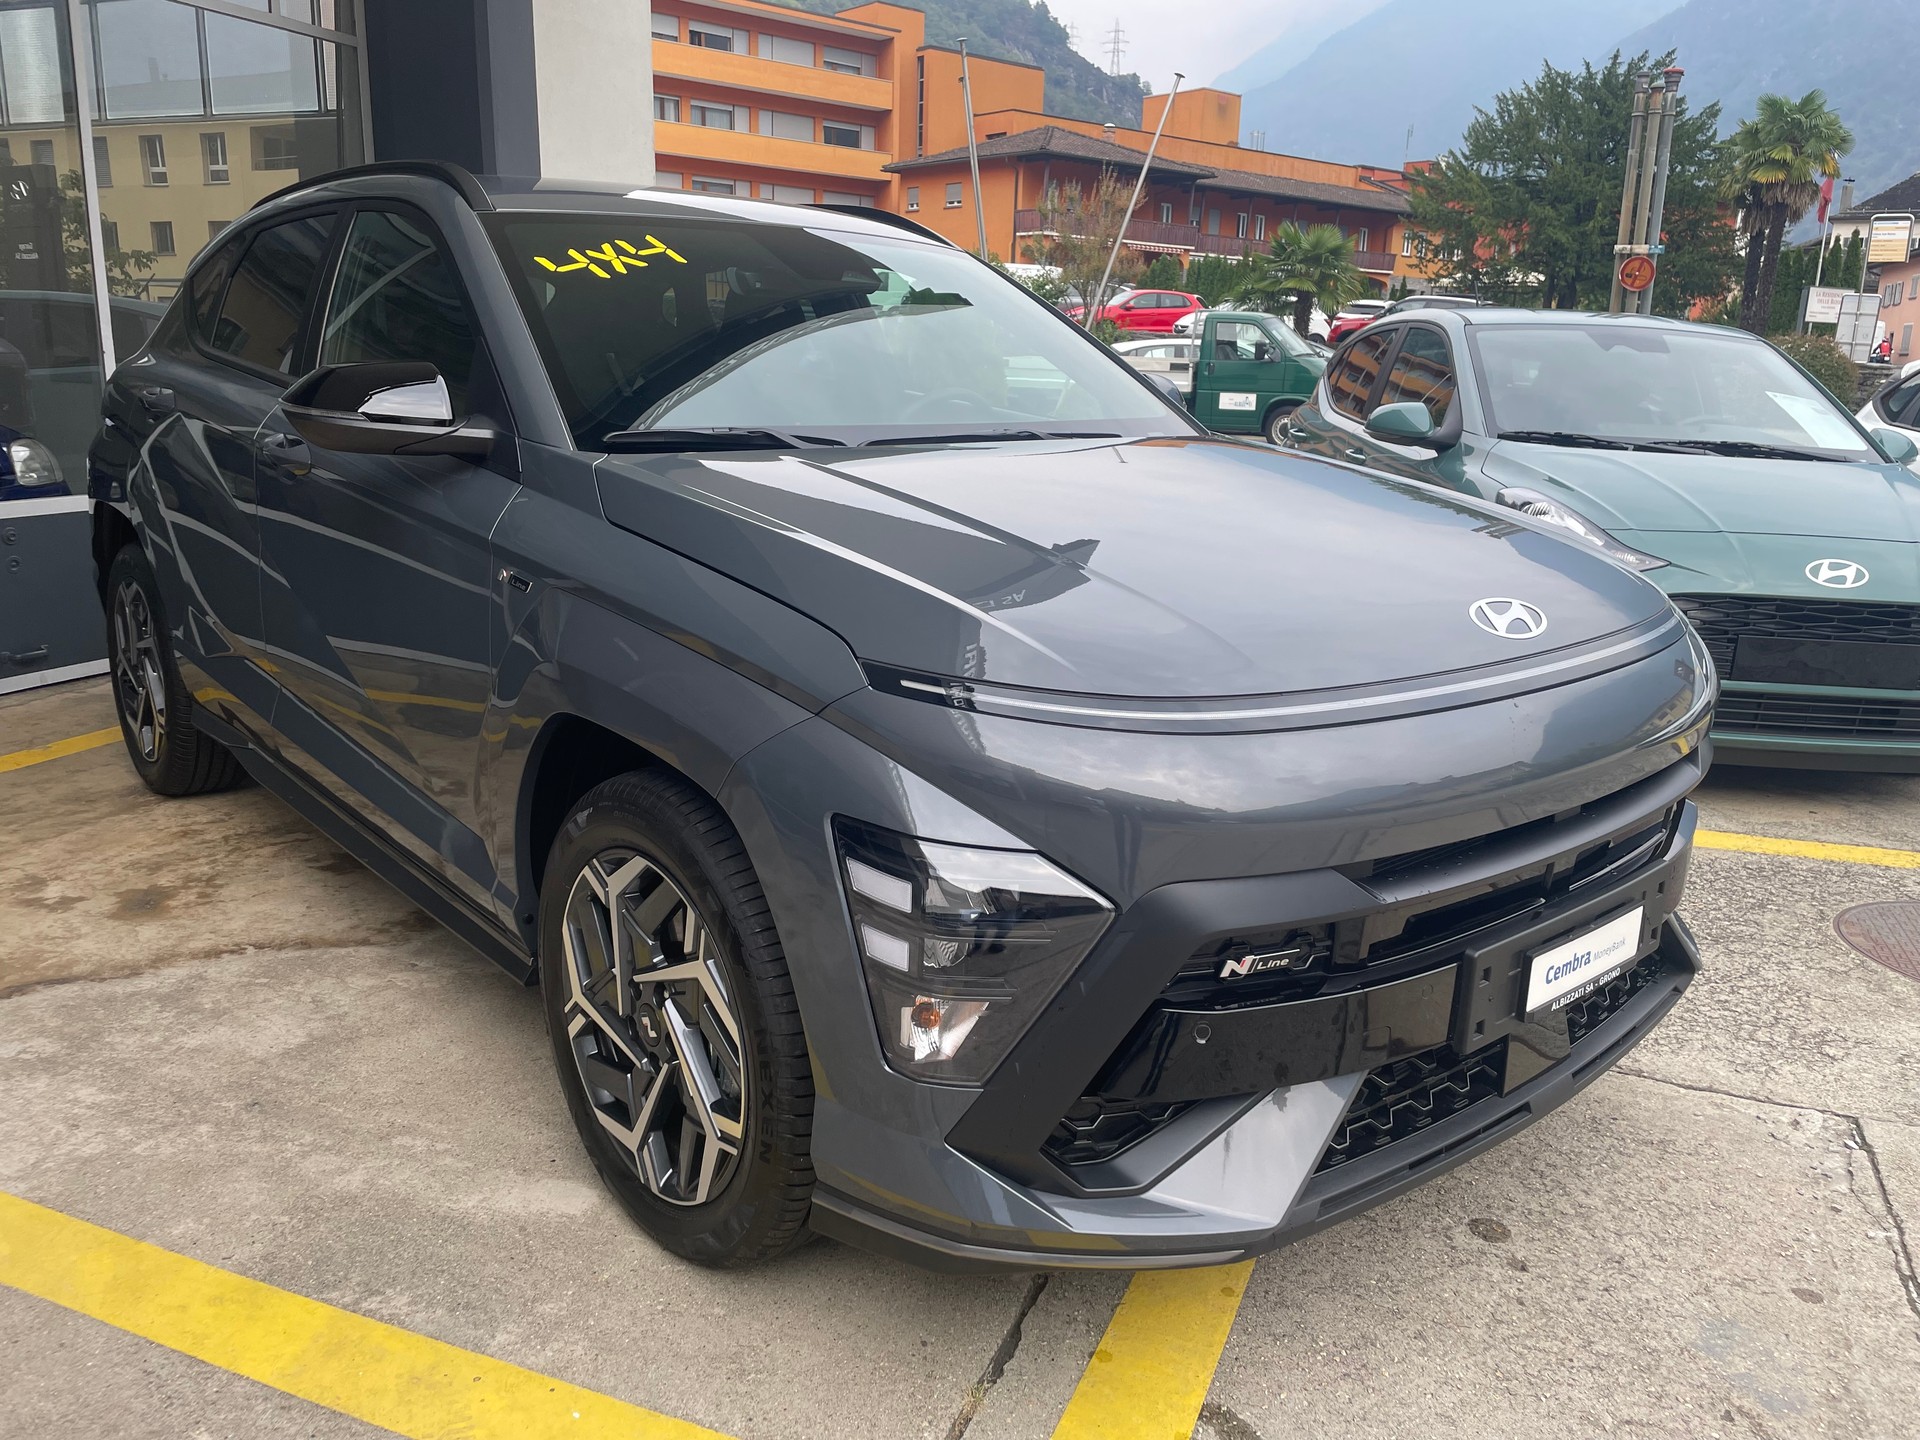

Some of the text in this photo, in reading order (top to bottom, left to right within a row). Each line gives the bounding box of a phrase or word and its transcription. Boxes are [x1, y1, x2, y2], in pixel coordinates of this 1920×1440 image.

[1220, 955, 1254, 977] N
[1545, 937, 1626, 985] Cembra MoneyBank
[1551, 987, 1585, 1012] ALBIZZATI
[1585, 982, 1594, 994] SA
[1599, 967, 1621, 986] GRONO
